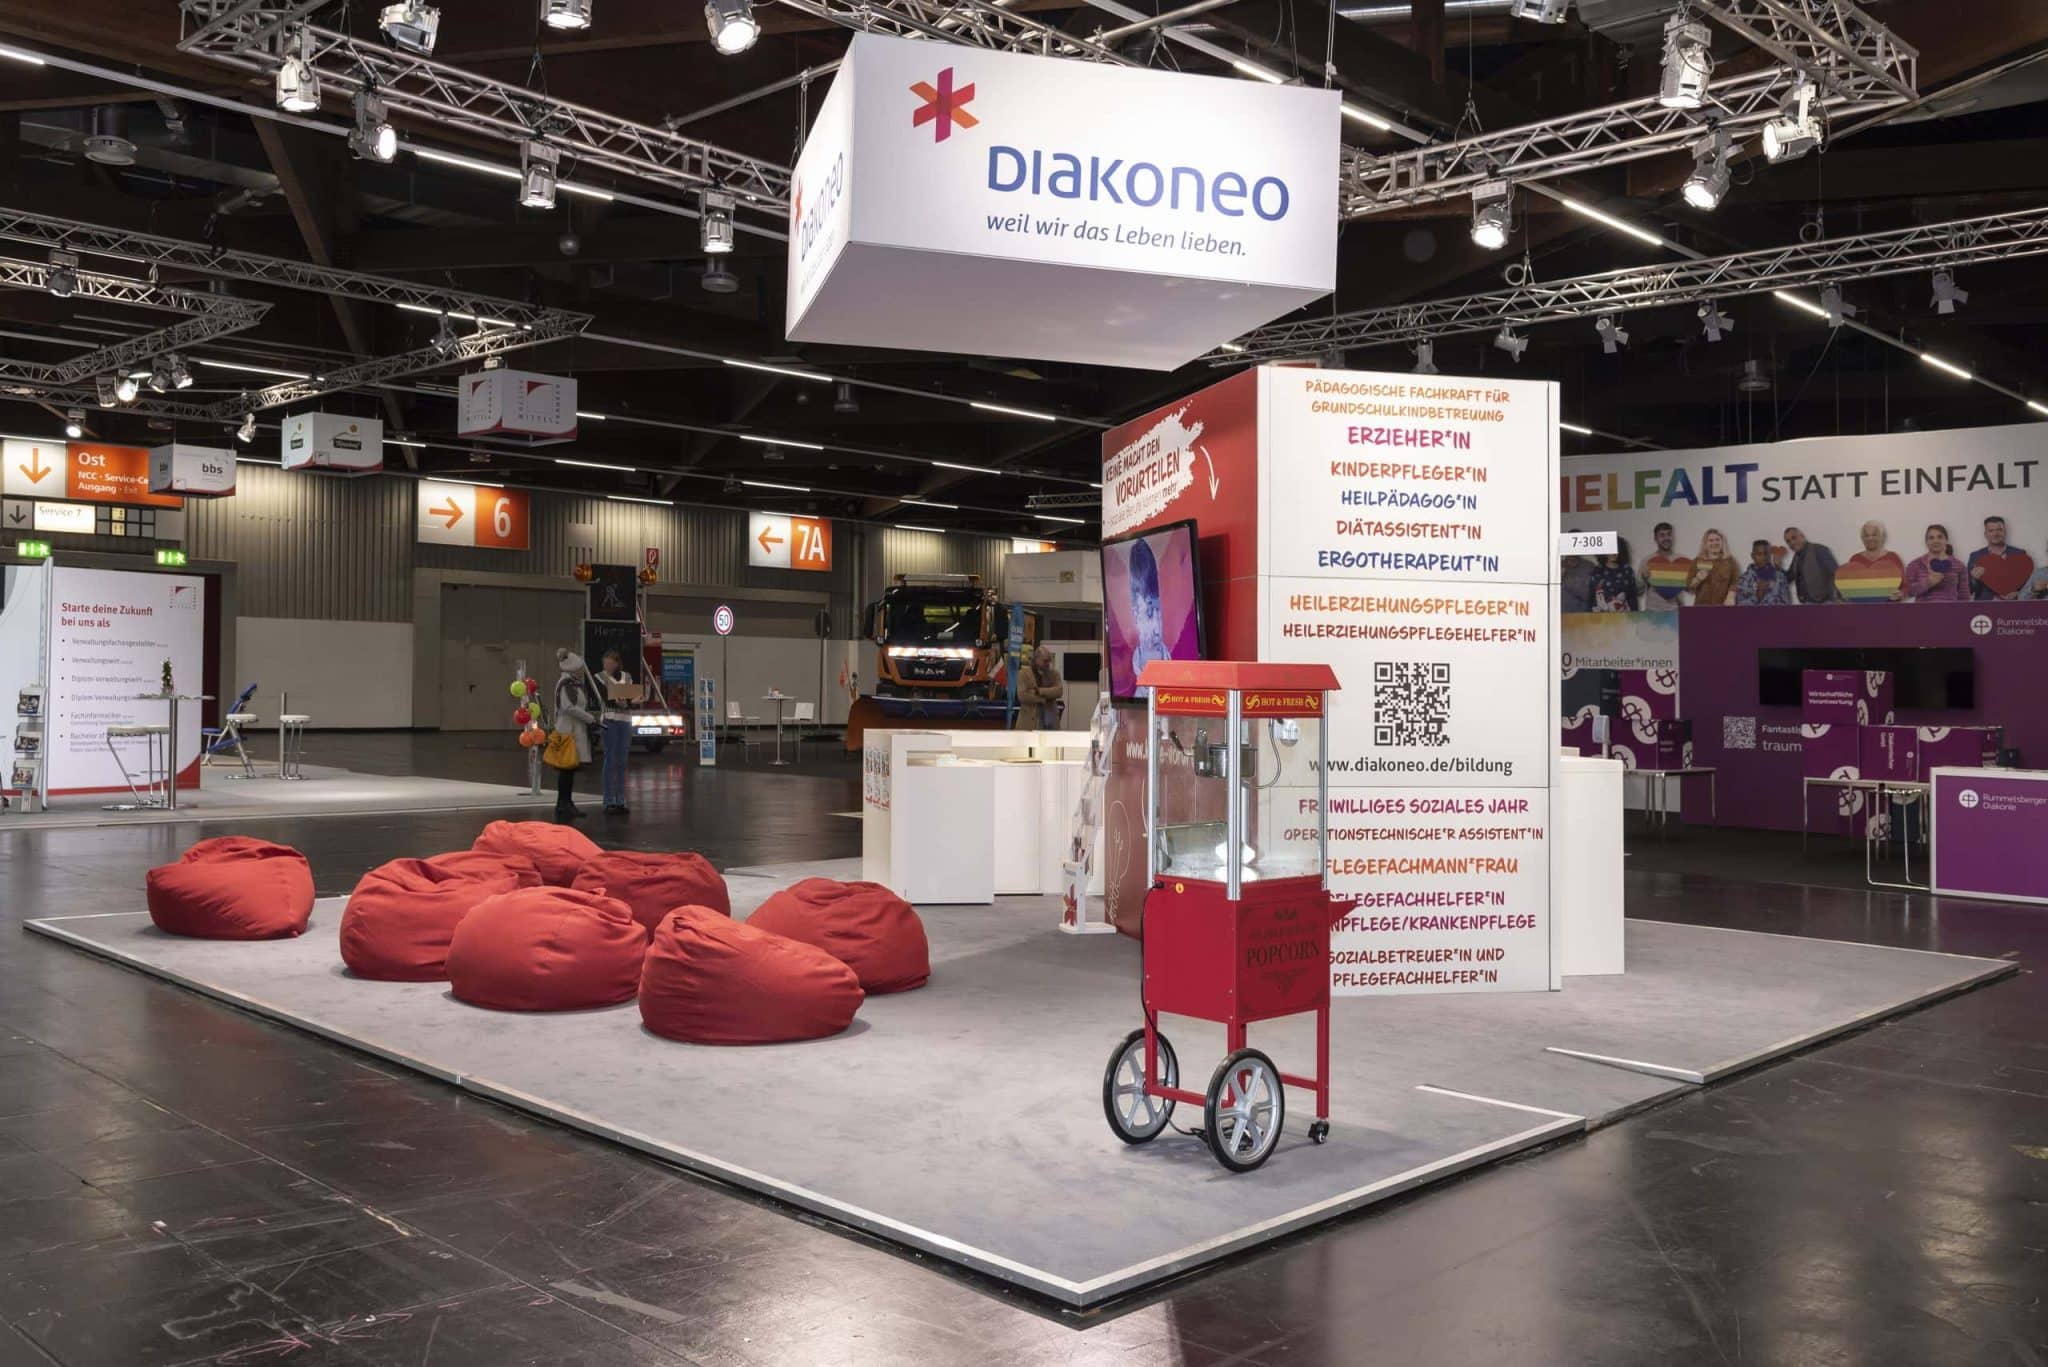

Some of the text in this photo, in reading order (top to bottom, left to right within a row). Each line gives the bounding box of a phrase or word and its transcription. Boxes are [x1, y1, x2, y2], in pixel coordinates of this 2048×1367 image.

[987, 213, 1248, 257] weil wir das Leben lieben.
[1306, 379, 1510, 403] PÄDAGOGISCHE FACHKRAFT FÜR
[1311, 400, 1504, 422] GRUNDSCHULKINDBETREUUNG
[78, 452, 106, 466] Ost
[1124, 445, 1146, 472] MACHT
[1147, 435, 1160, 461] DEN
[78, 471, 97, 480] NCC
[202, 463, 224, 475] bbs
[1115, 447, 1180, 507] VORURTEILEN
[78, 482, 117, 494] Ausgang
[1560, 460, 2039, 513] IELFALT STATT EINFALT
[39, 505, 74, 517] Service
[493, 496, 512, 538] 6
[797, 524, 825, 562] 7A
[1571, 536, 1604, 548] 7-308
[61, 602, 153, 617] Starte deine Zukunft
[61, 617, 111, 628] bei uns als
[718, 613, 729, 627] 50
[1261, 697, 1275, 706] HOT
[1283, 697, 1304, 706] FRESH
[1299, 799, 1529, 814] FRIWILLIGES SOZIALES JAHR
[1284, 828, 1456, 841] OPERTIONSTECHNISCHER
[1246, 940, 1320, 968] POPCORN
[1476, 948, 1505, 962] UND
